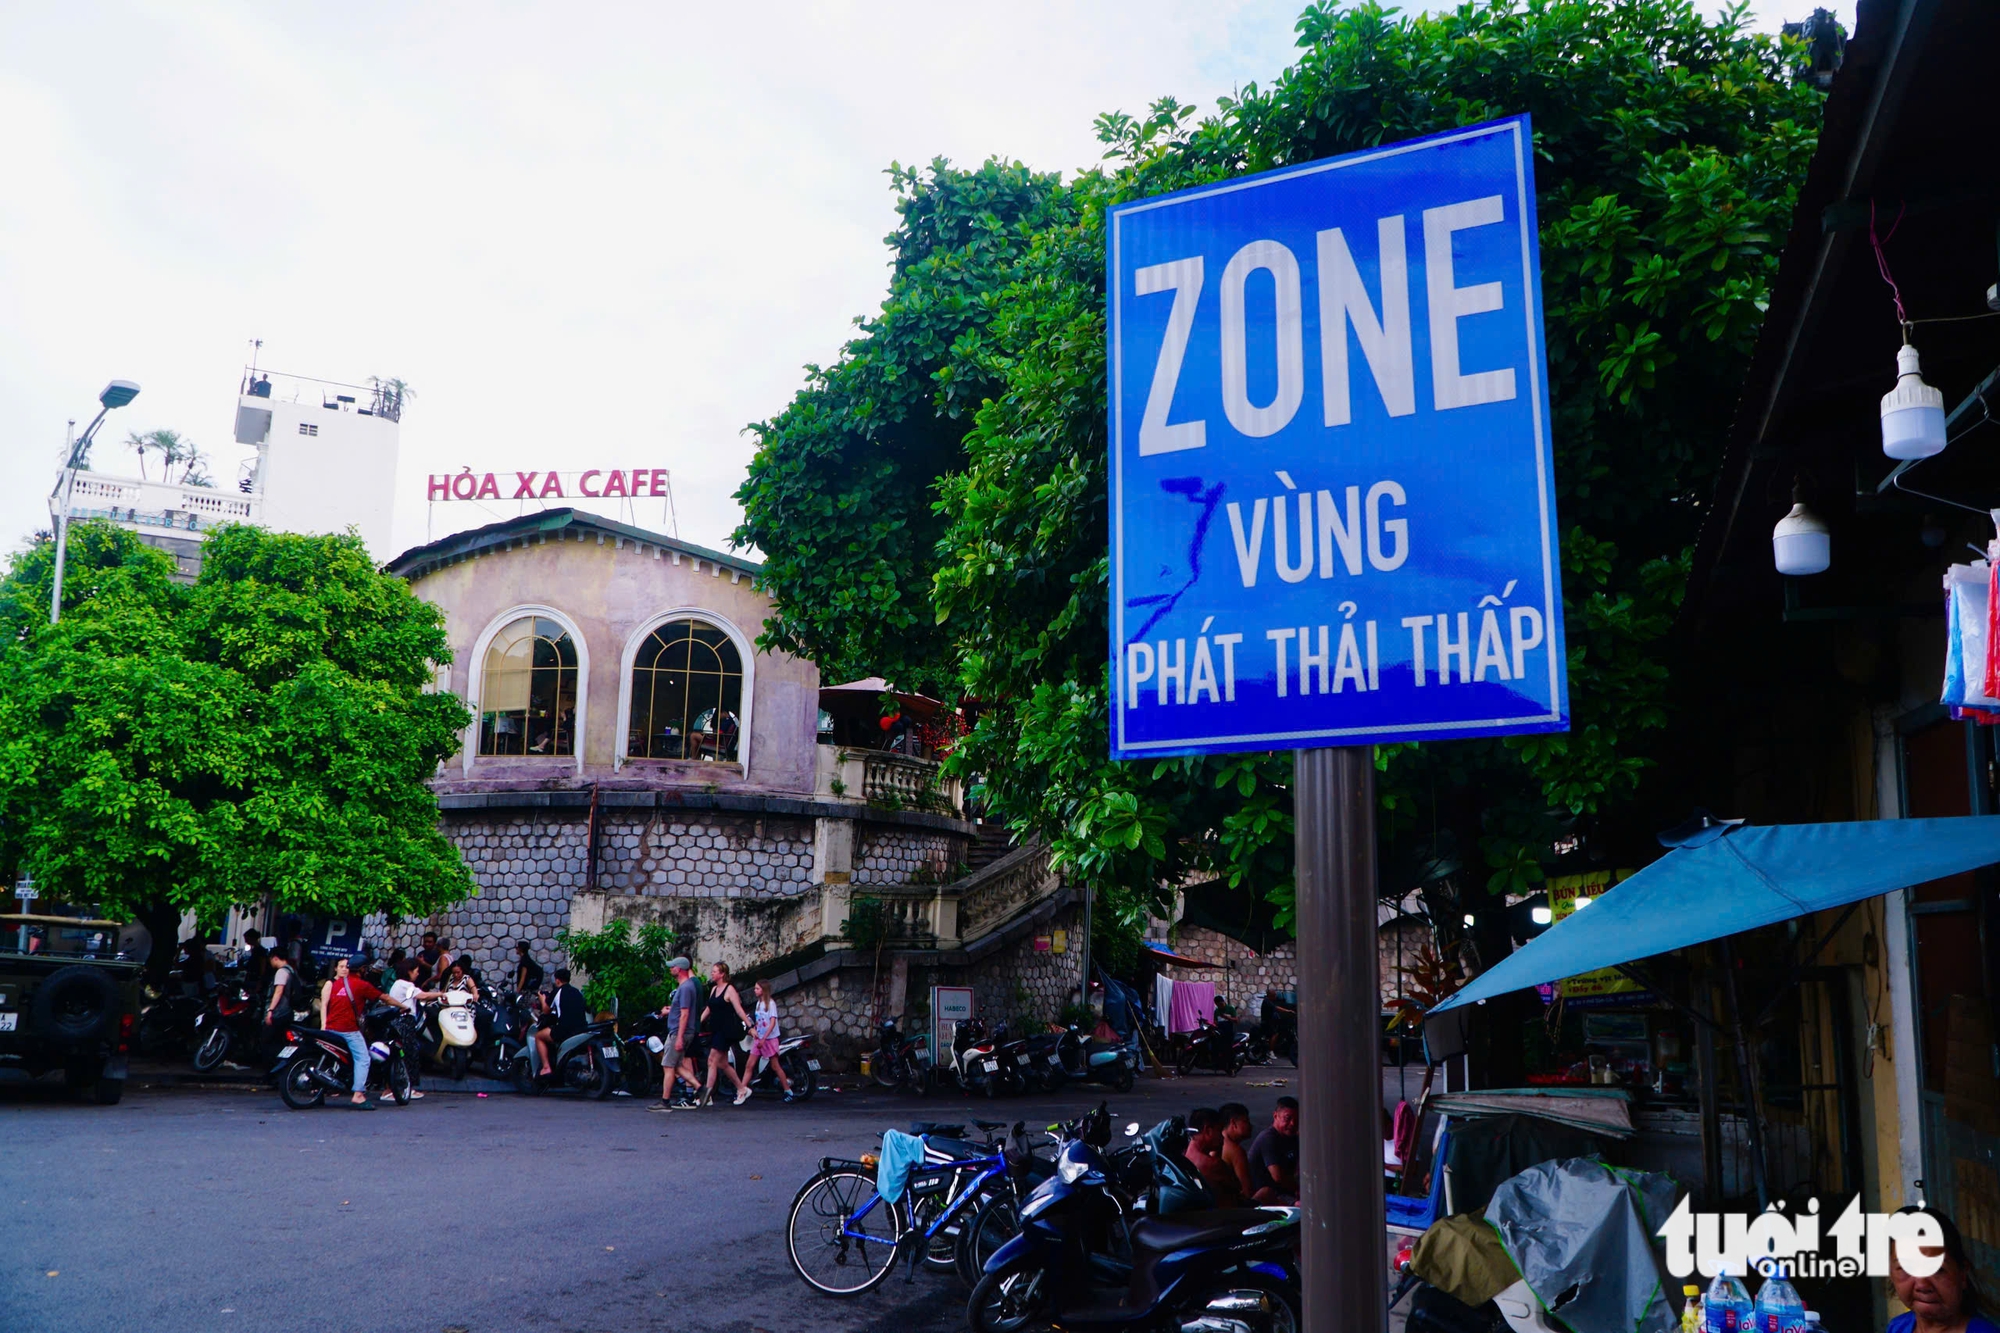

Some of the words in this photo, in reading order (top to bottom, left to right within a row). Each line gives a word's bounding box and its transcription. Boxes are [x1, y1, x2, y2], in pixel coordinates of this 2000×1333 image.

[1135, 195, 1517, 457] ZONE
[428, 466, 500, 500] HỎA
[513, 471, 564, 499] XA
[579, 469, 667, 497] CAFE
[1227, 470, 1410, 588] VÙNG
[1128, 615, 1243, 709] PHÁT
[1267, 601, 1379, 697] THẢI
[1402, 579, 1544, 687] THẤP
[1553, 885, 1576, 901] BÚN
[326, 920, 347, 945] P
